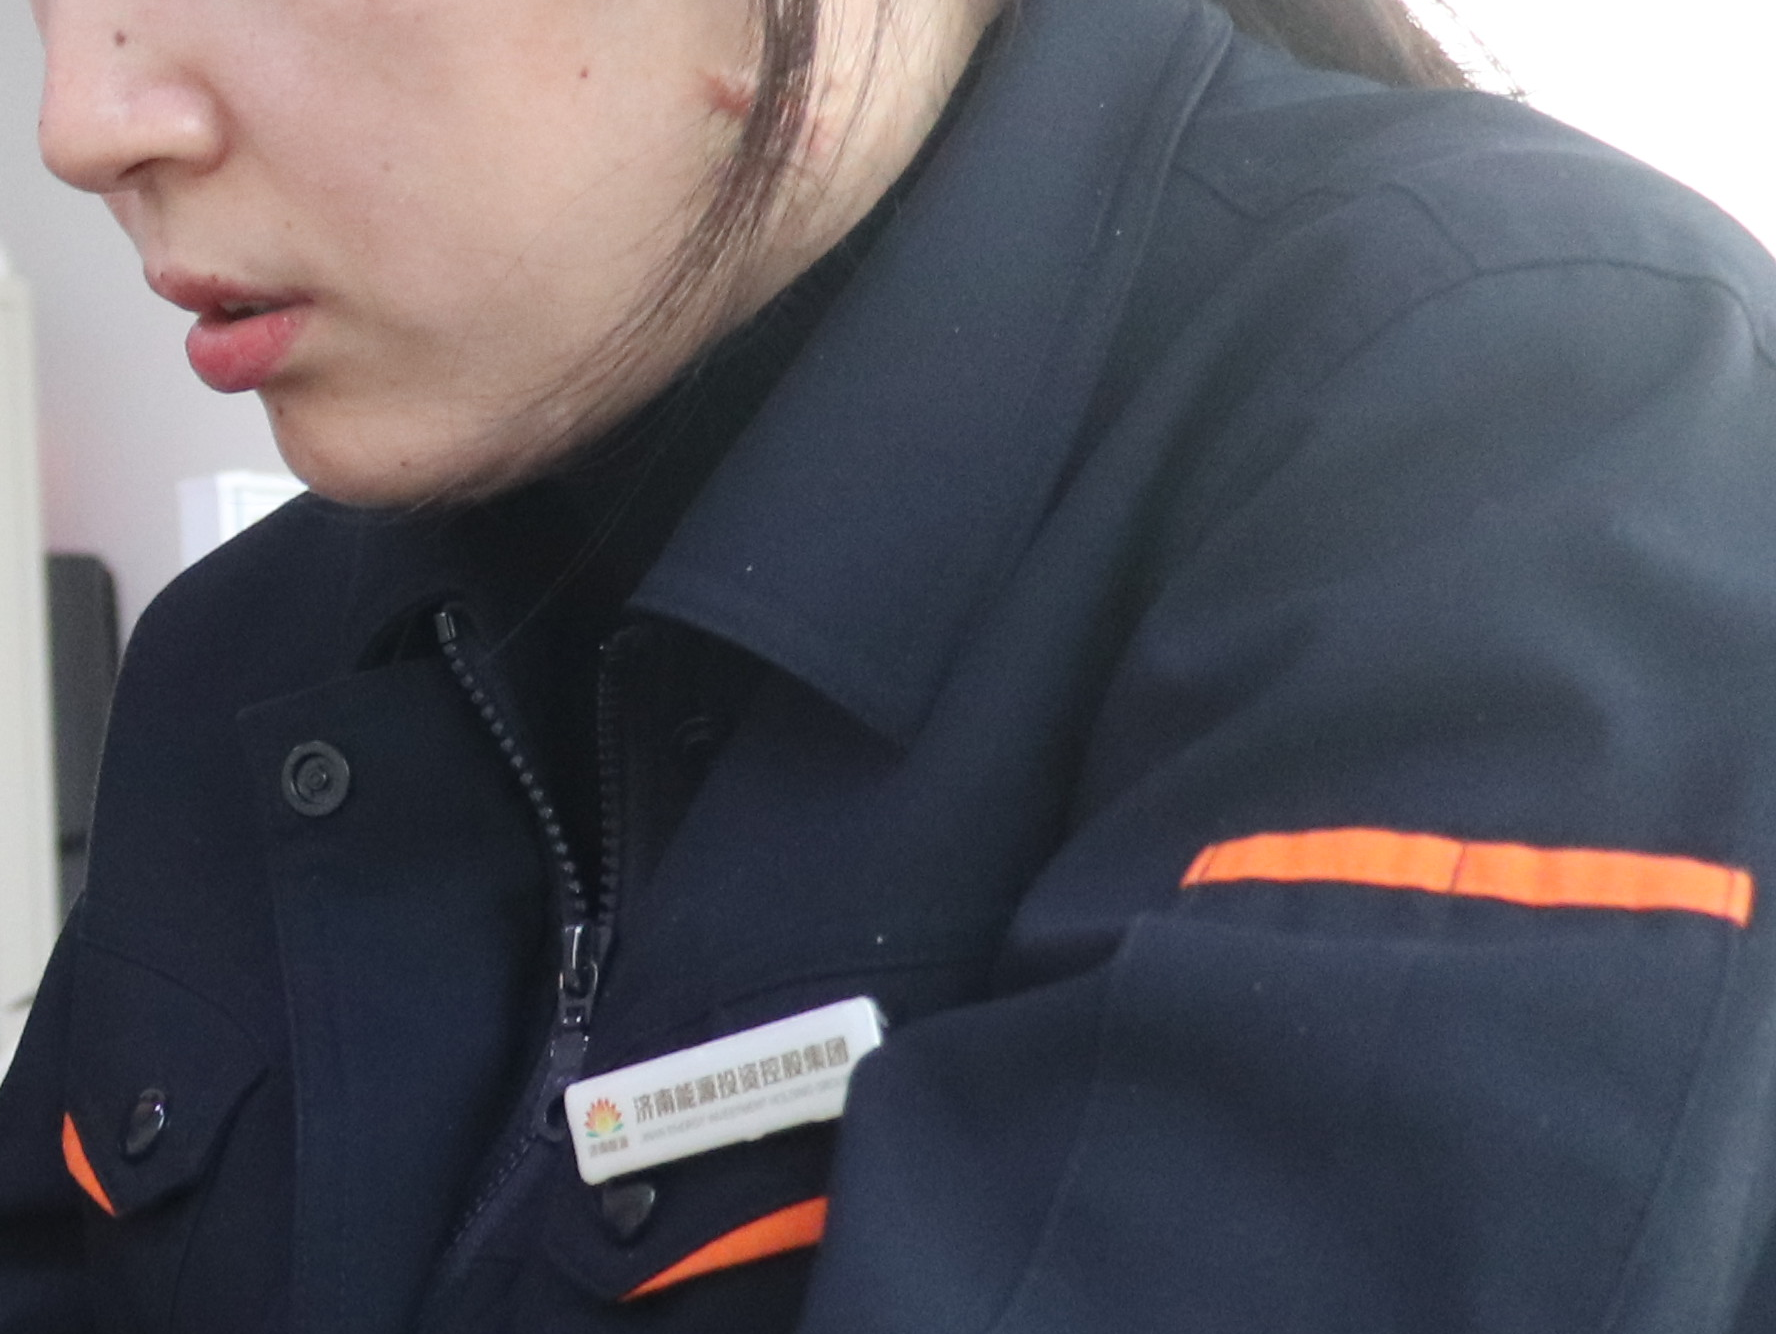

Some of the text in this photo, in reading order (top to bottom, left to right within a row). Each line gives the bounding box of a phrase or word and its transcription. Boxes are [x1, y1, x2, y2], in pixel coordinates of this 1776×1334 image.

[634, 1037, 849, 1124] 济南能源投资控股集团
